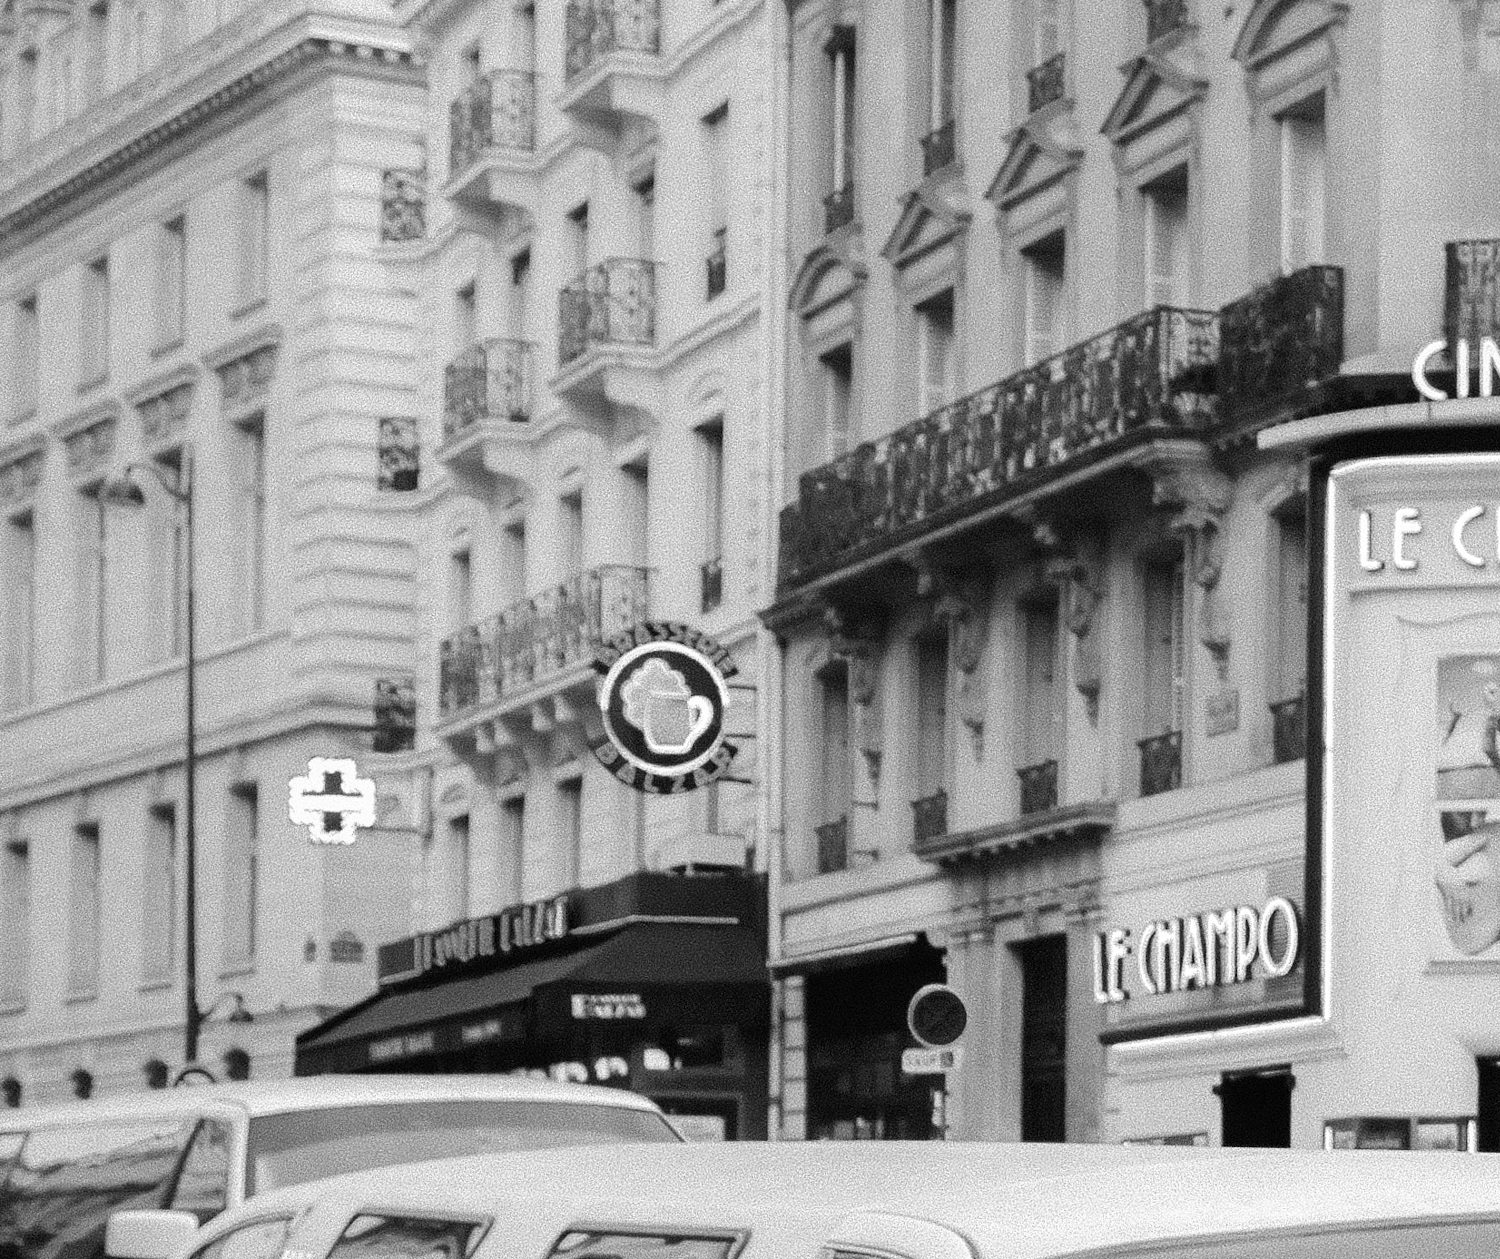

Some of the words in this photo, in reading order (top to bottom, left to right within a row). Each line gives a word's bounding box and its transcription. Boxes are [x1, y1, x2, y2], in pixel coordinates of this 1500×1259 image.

[1358, 505, 1423, 571] LE
[1094, 928, 1132, 1004] LE
[1138, 896, 1299, 995] CHAMPO
